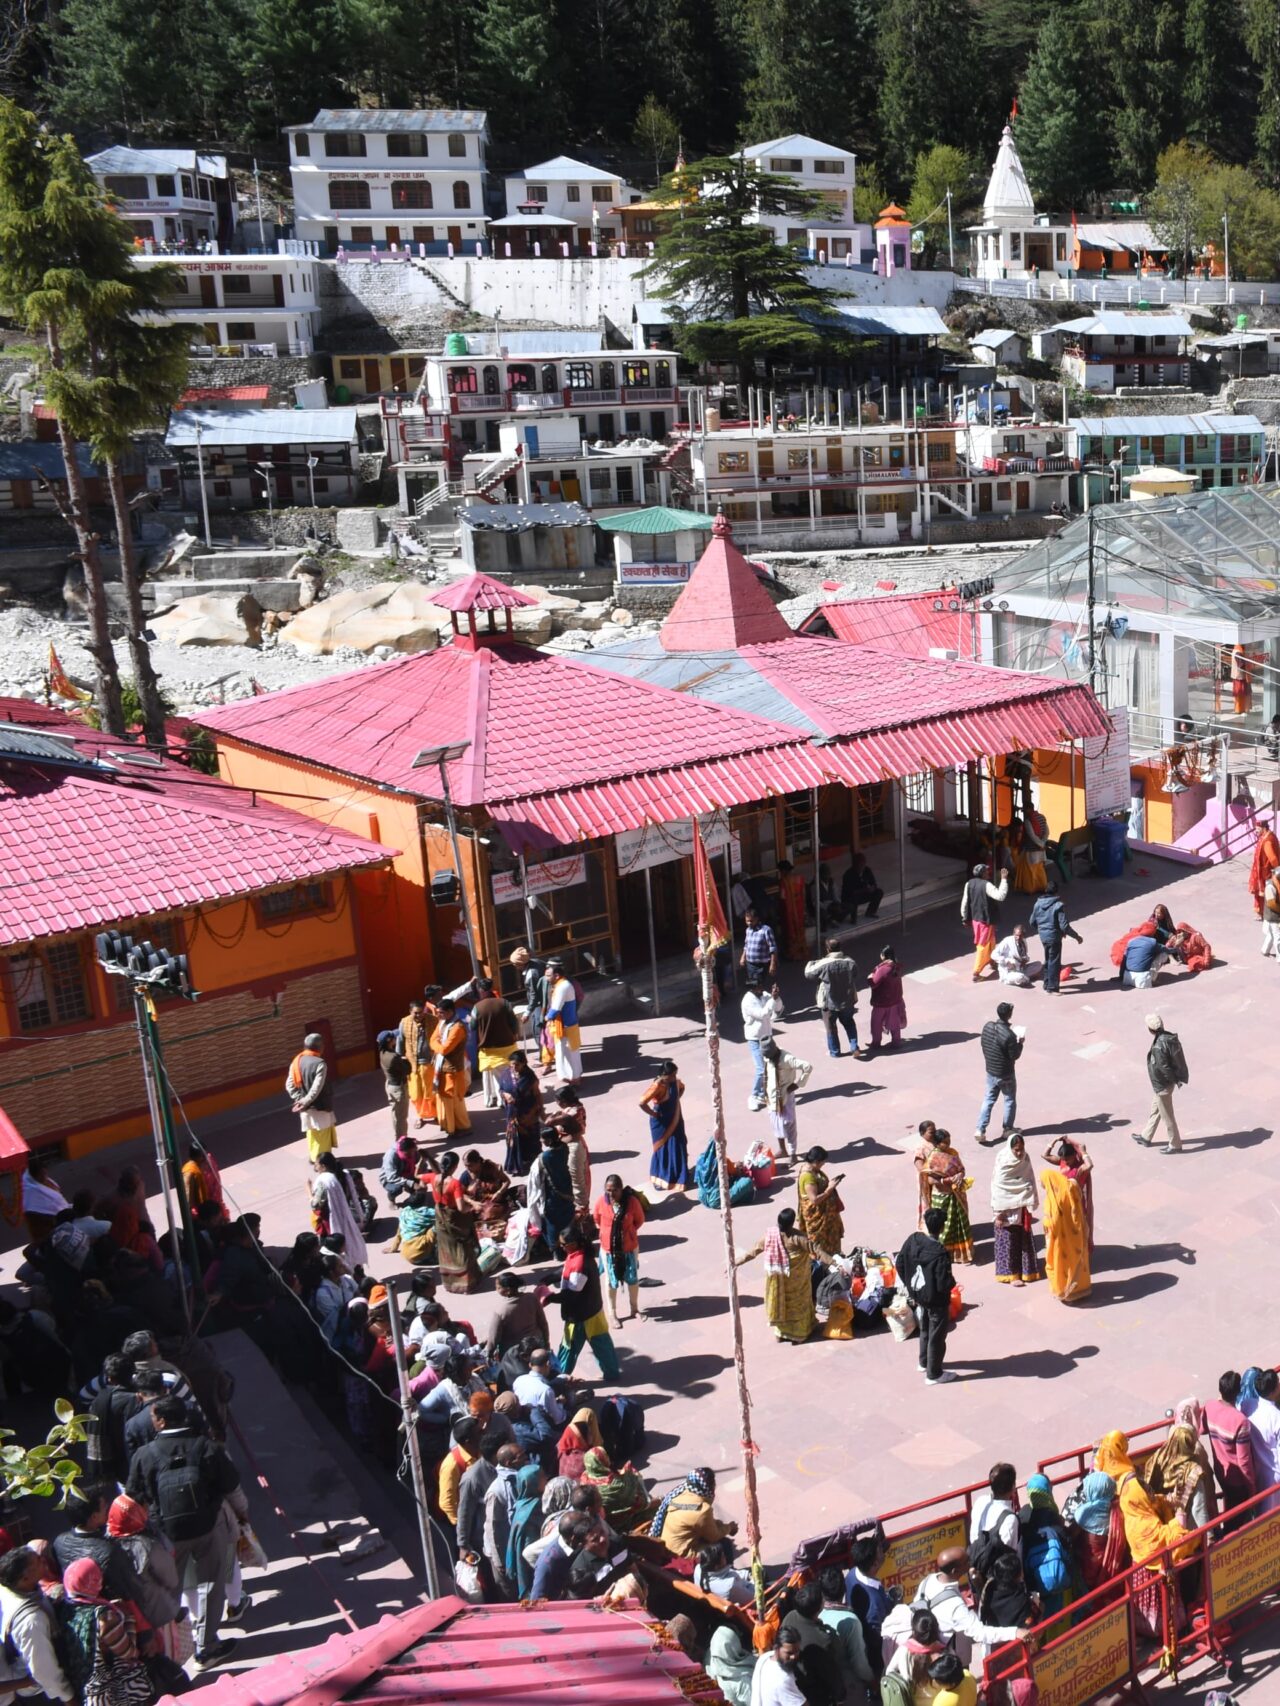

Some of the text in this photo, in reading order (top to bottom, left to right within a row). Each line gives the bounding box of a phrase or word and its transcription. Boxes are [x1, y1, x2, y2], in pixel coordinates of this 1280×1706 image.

[661, 565, 678, 576] सेवा
[680, 564, 687, 577] है
[1210, 1552, 1224, 1572] श्री
[1231, 1536, 1261, 1558] मन्दिर
[1061, 1658, 1100, 1694] मन्दिर
[1099, 1640, 1127, 1669] समिति
